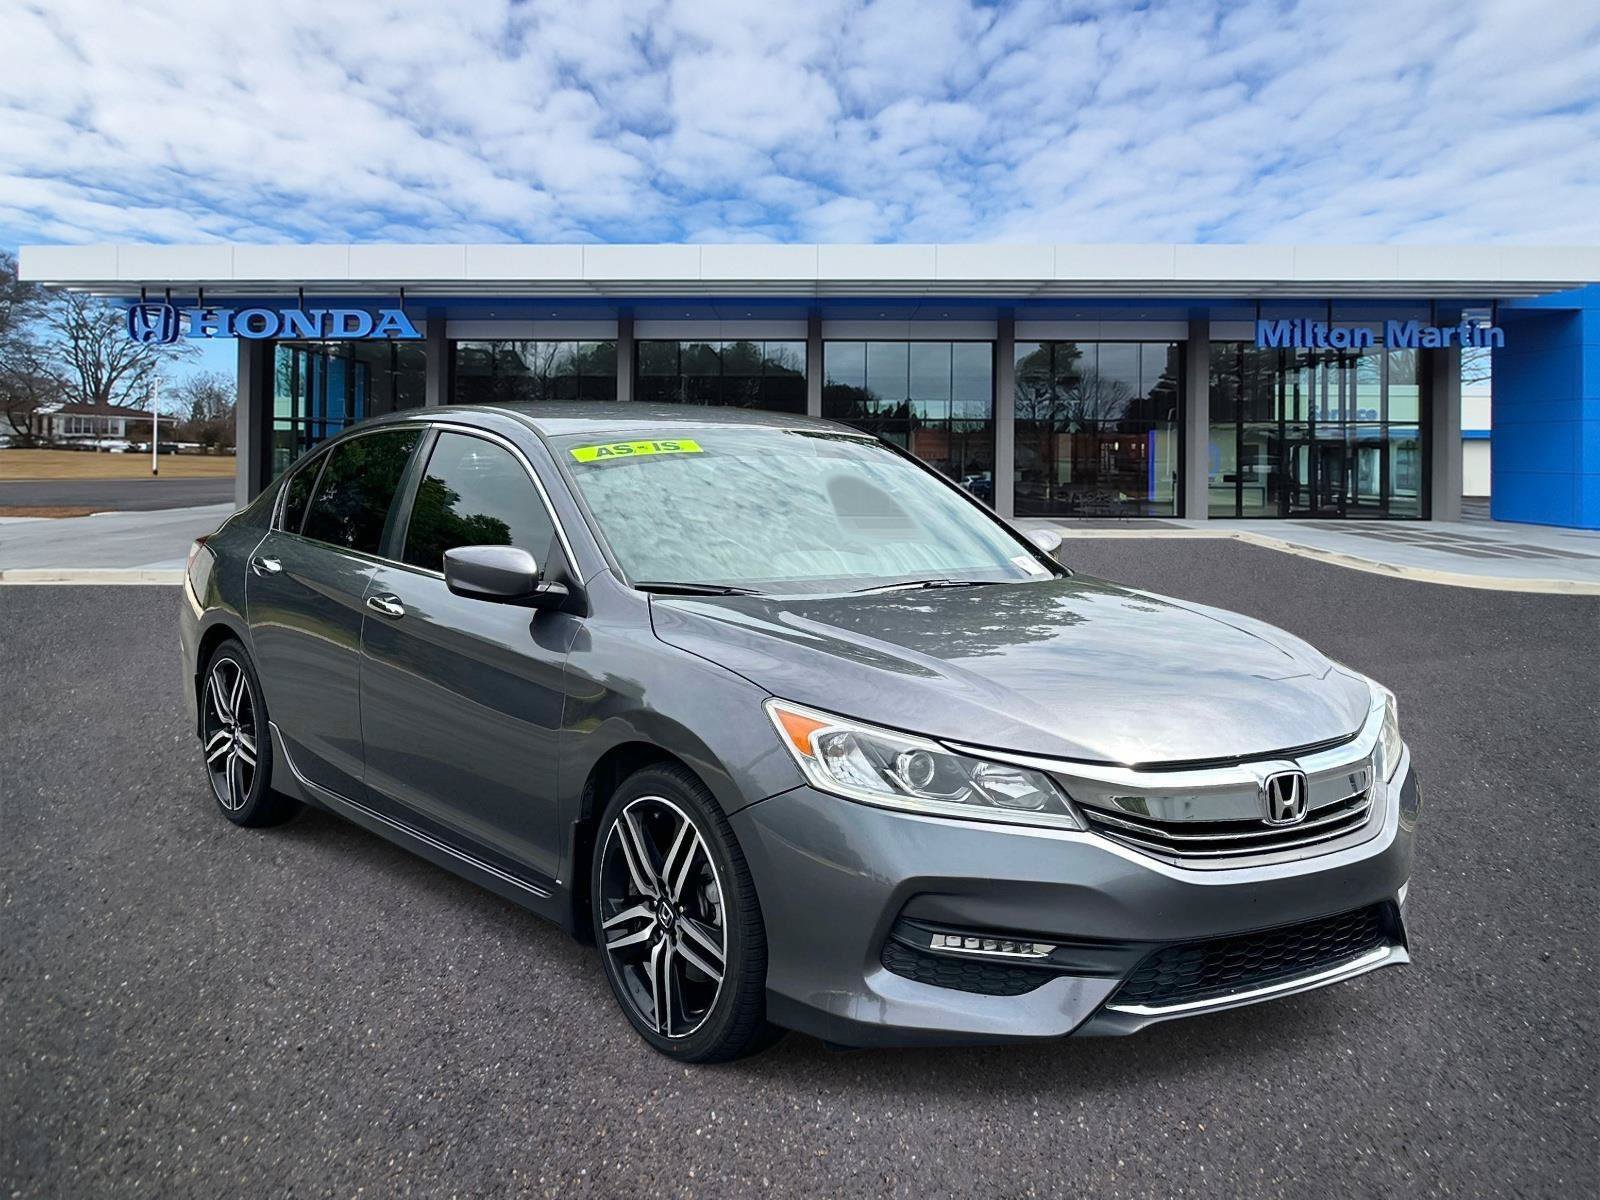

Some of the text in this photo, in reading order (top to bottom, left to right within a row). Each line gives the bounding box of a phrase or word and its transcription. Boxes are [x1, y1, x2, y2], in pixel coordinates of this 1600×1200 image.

[188, 309, 423, 339] HONDA
[1257, 319, 1505, 348] Milton Martin
